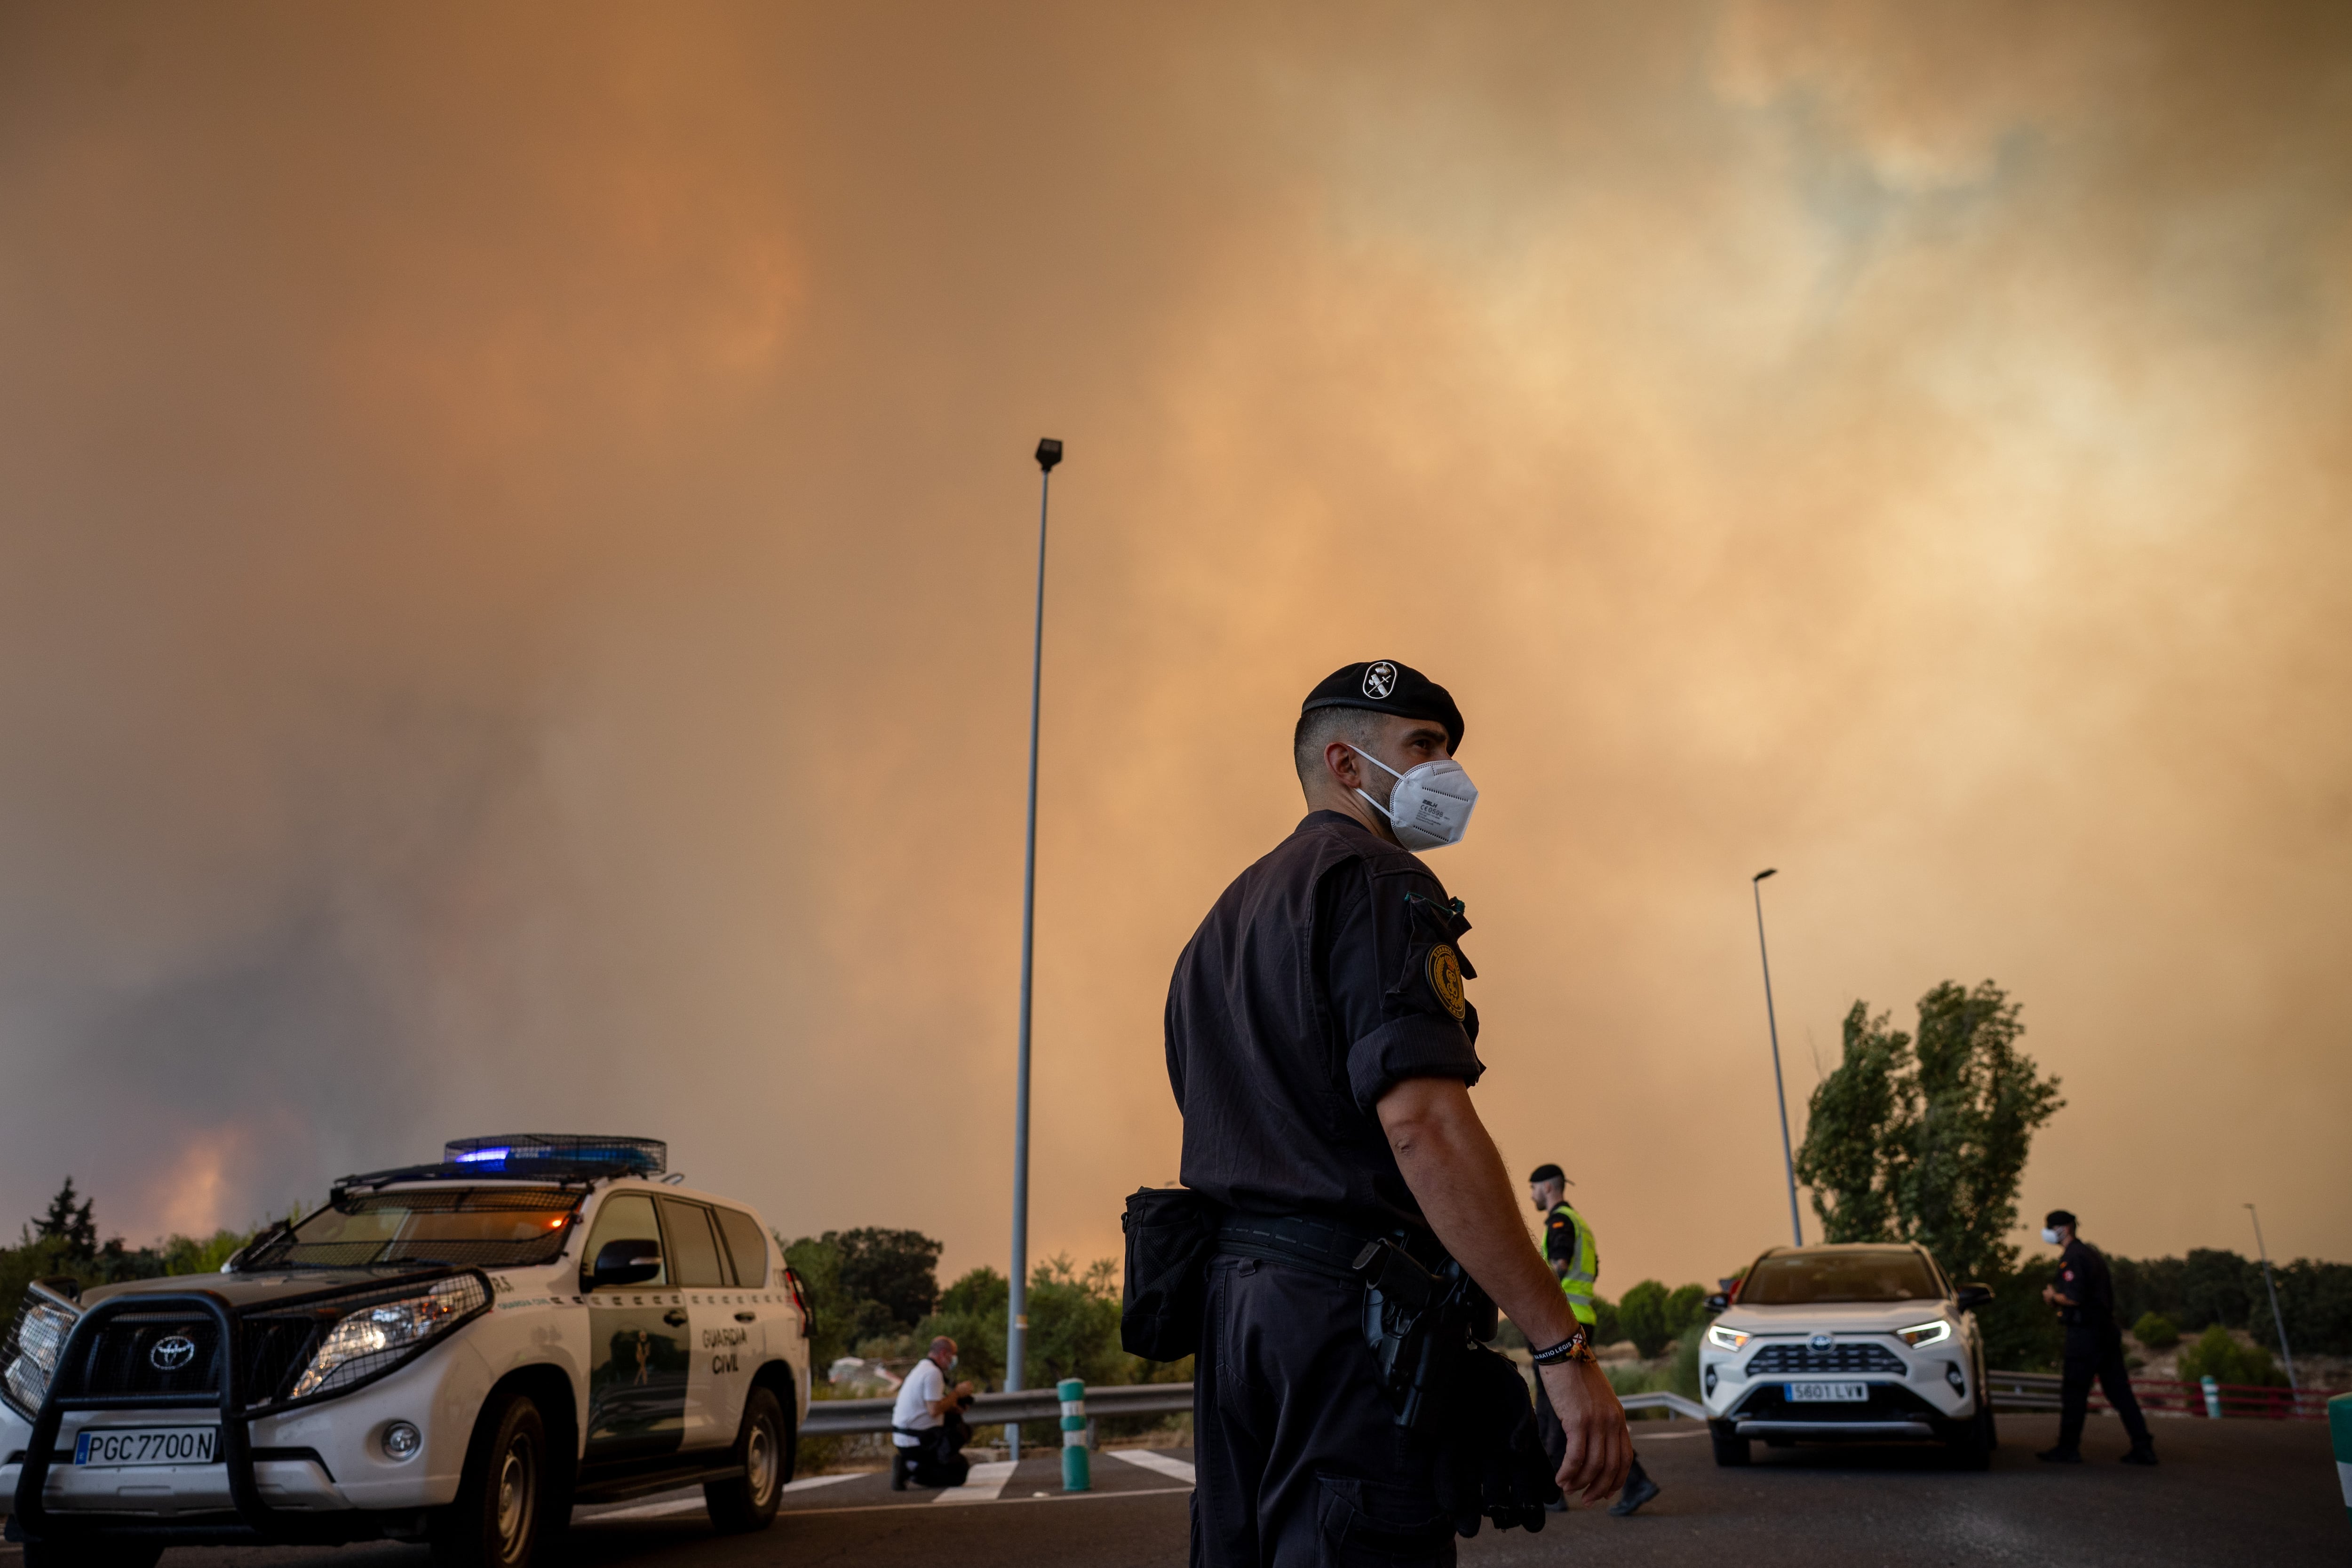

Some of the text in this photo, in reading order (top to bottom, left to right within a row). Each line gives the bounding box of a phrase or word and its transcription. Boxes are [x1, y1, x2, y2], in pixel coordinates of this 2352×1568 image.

[702, 1328, 747, 1348] GUARDIA
[1538, 1350, 1554, 1359] RATIO
[1555, 1341, 1572, 1354] LEGIS
[712, 1354, 739, 1374] CIVIL
